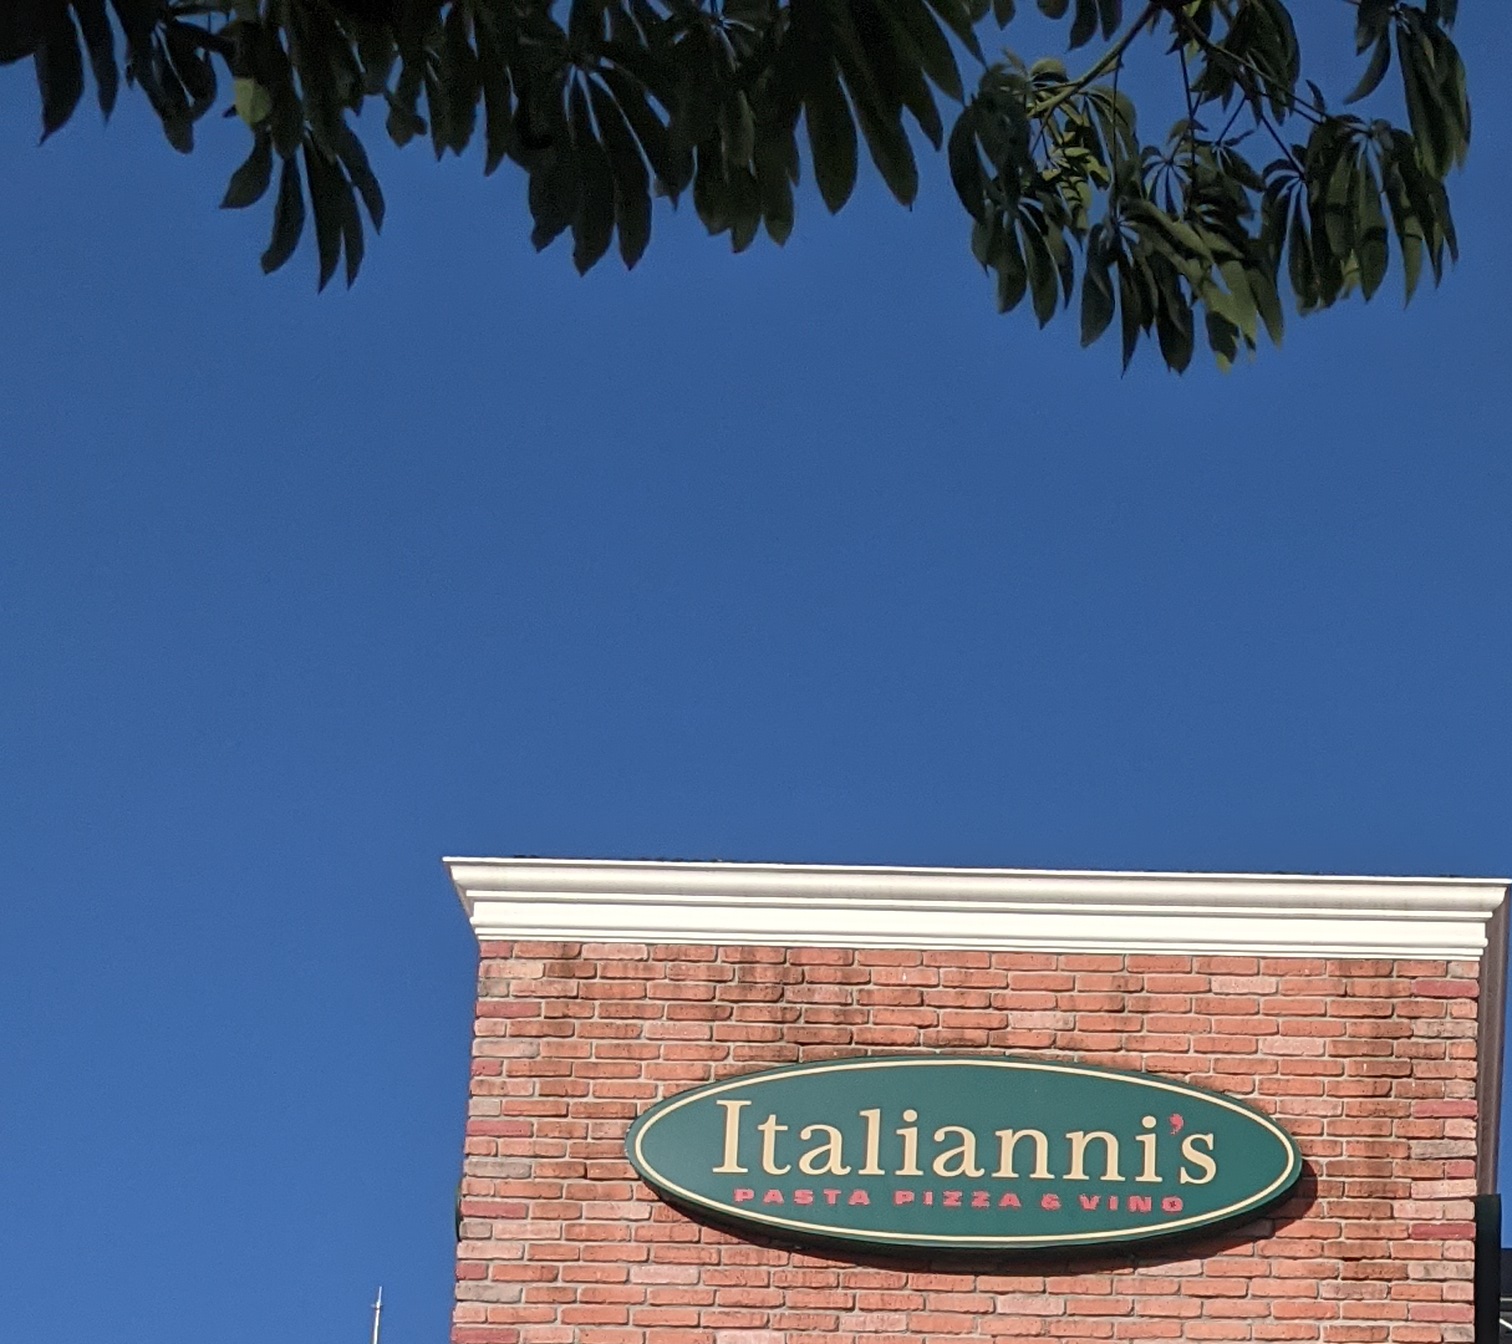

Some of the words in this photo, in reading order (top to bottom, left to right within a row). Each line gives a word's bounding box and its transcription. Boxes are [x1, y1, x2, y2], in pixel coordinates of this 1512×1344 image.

[712, 1098, 1217, 1185] Italianni's
[732, 1187, 871, 1206] PASTA
[894, 1190, 1021, 1208] PIZZA
[1040, 1193, 1062, 1211] &
[1080, 1193, 1186, 1213] VINO
